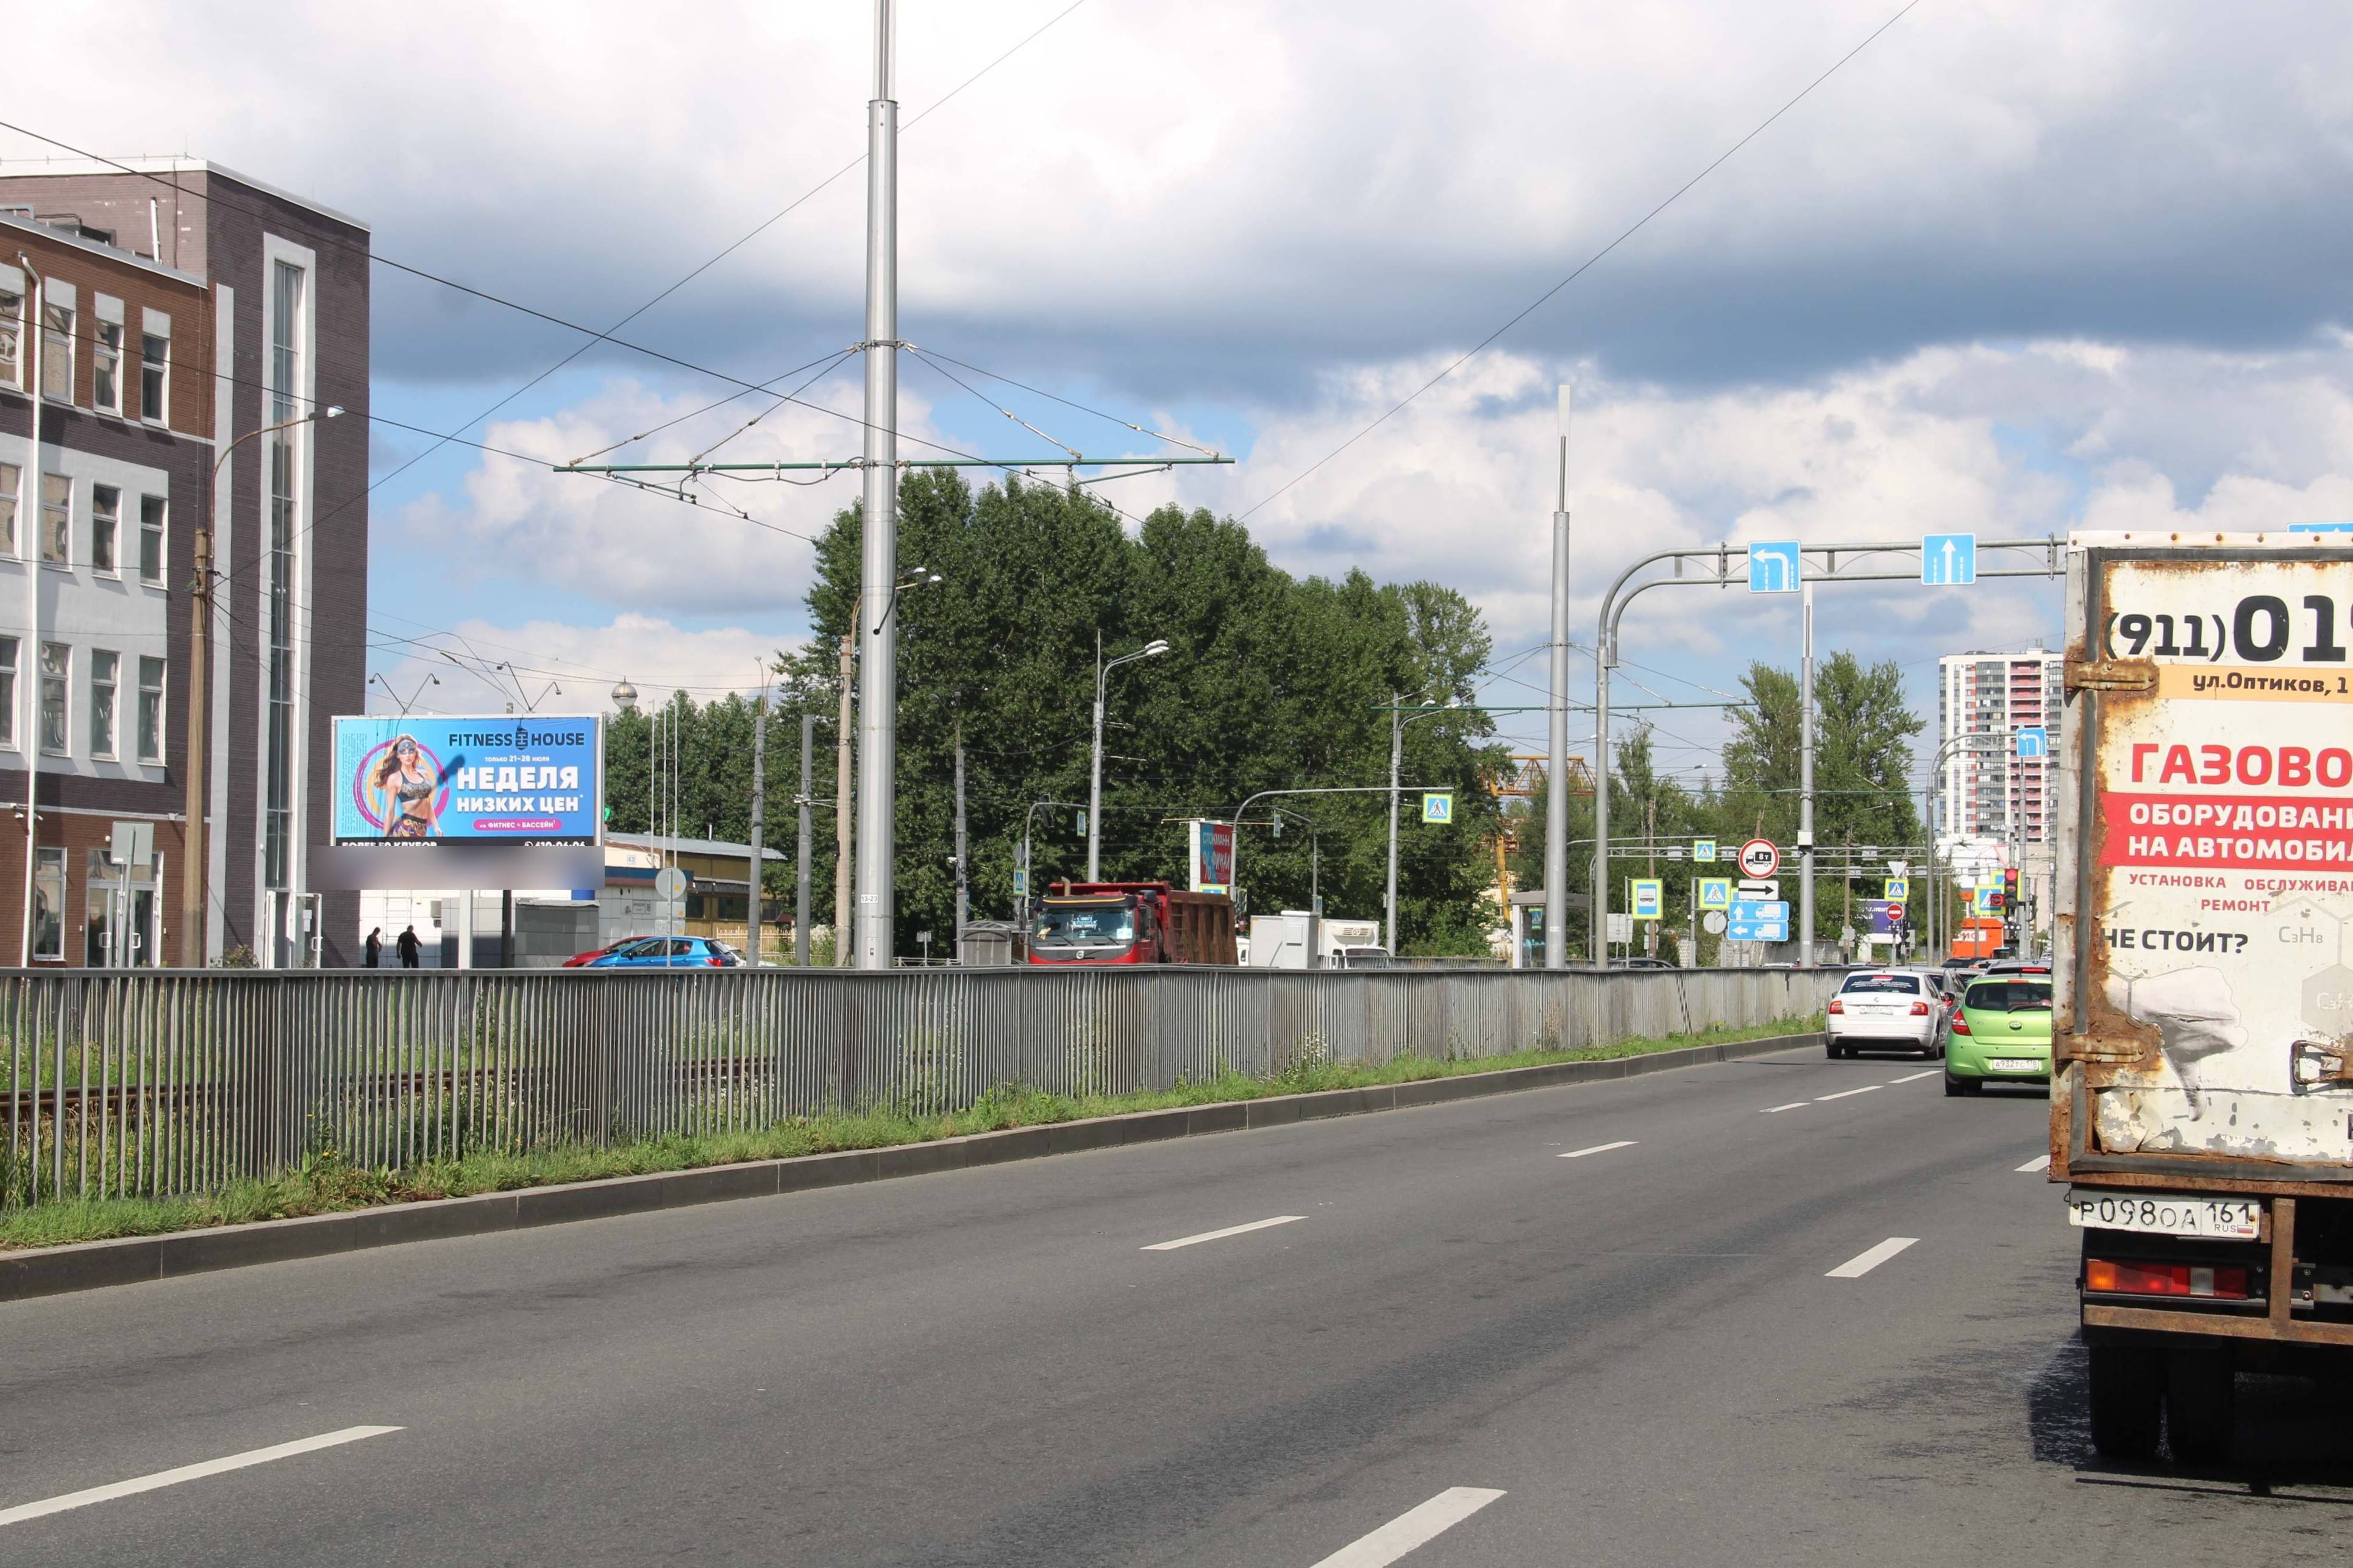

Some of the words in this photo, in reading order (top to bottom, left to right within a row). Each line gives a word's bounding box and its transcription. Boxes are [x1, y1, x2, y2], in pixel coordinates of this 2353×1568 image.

[2104, 595, 2353, 662] (911)01
[449, 733, 513, 747] FITNESS
[531, 733, 585, 746] HOUSE
[2132, 743, 2353, 788] ГАЗОВО
[457, 766, 579, 793] НЕДЕЛЯ
[457, 796, 535, 812] НИЗКИХ
[2129, 836, 2169, 857] НА
[2175, 838, 2353, 861] АВТОМОБИ
[2129, 874, 2226, 888] УСТАНОВКА
[2244, 879, 2353, 892] ОБСЛУЖИВА
[2201, 899, 2271, 912] РЕМОНТ
[2141, 930, 2248, 954] СТОИТ?
[2206, 1202, 2250, 1224] 161
[2214, 1224, 2237, 1232] RUS
